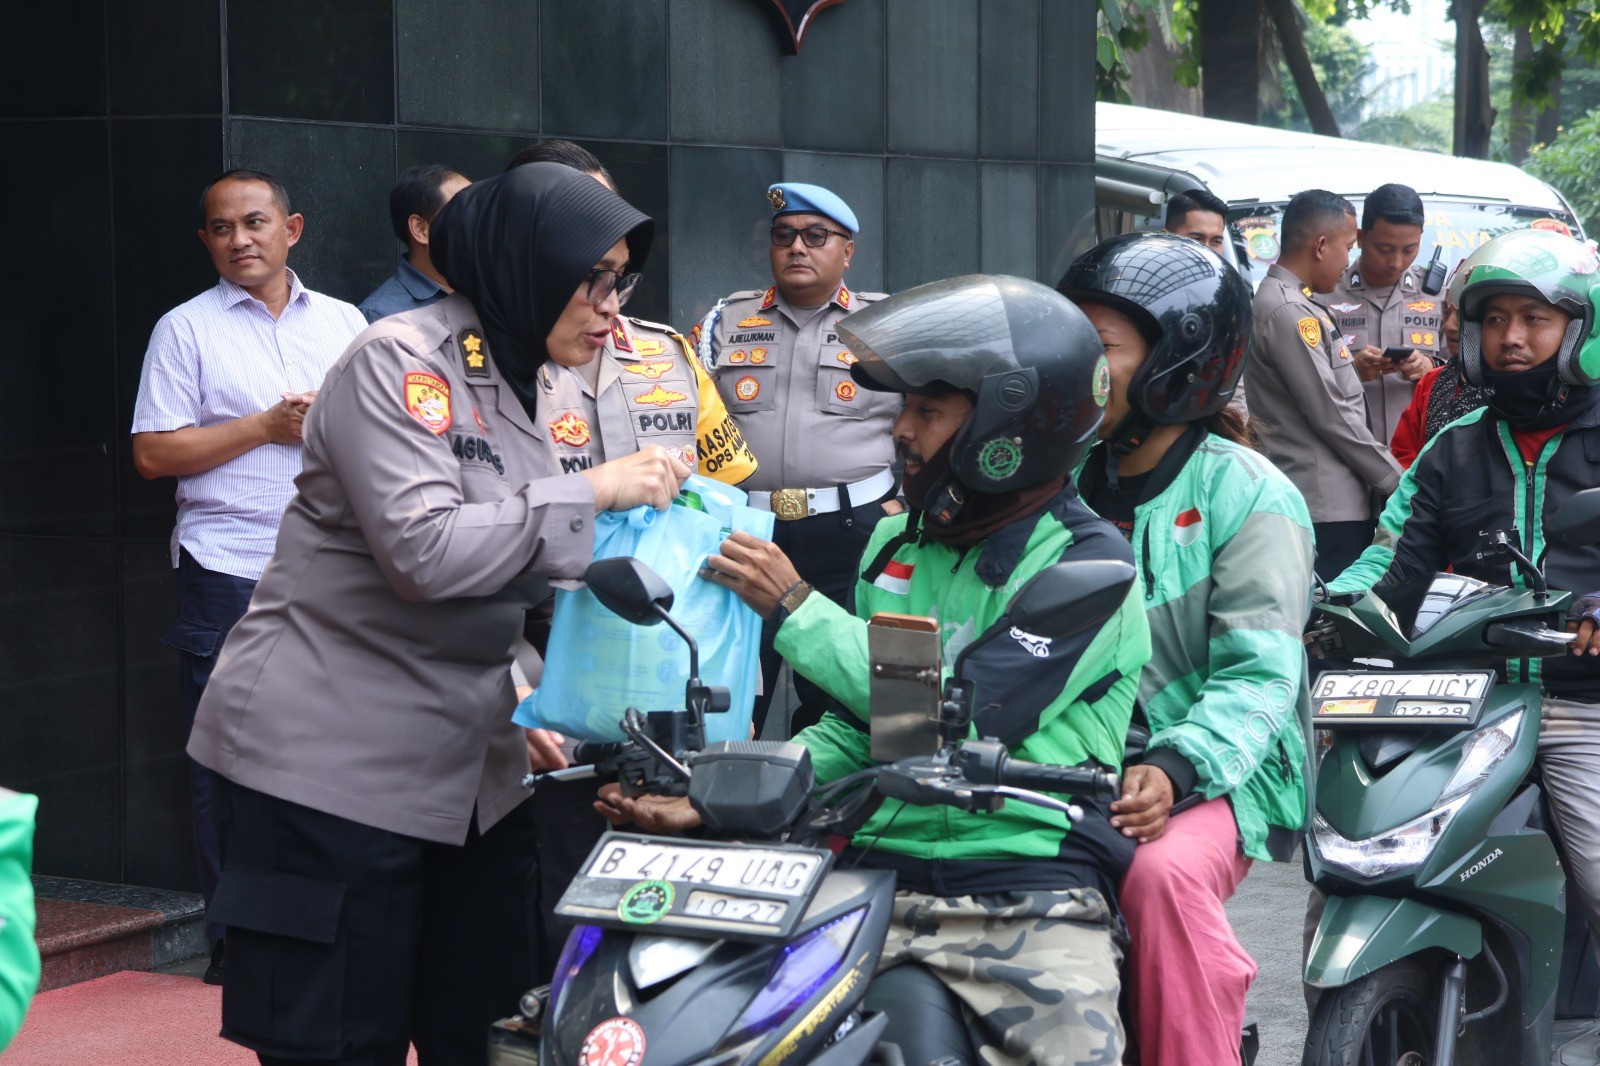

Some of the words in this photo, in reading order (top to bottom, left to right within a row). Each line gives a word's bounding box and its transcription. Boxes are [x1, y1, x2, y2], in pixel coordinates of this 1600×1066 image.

[1404, 316, 1438, 328] POLRI
[638, 412, 693, 432] POLRI
[706, 448, 734, 473] OPS
[1320, 680, 1337, 697] B
[1347, 679, 1412, 698] 4804
[1427, 678, 1478, 697] UCY
[1212, 678, 1294, 786] Grab
[599, 847, 627, 875] B
[637, 852, 725, 883] 4149
[1459, 847, 1504, 883] HONDA
